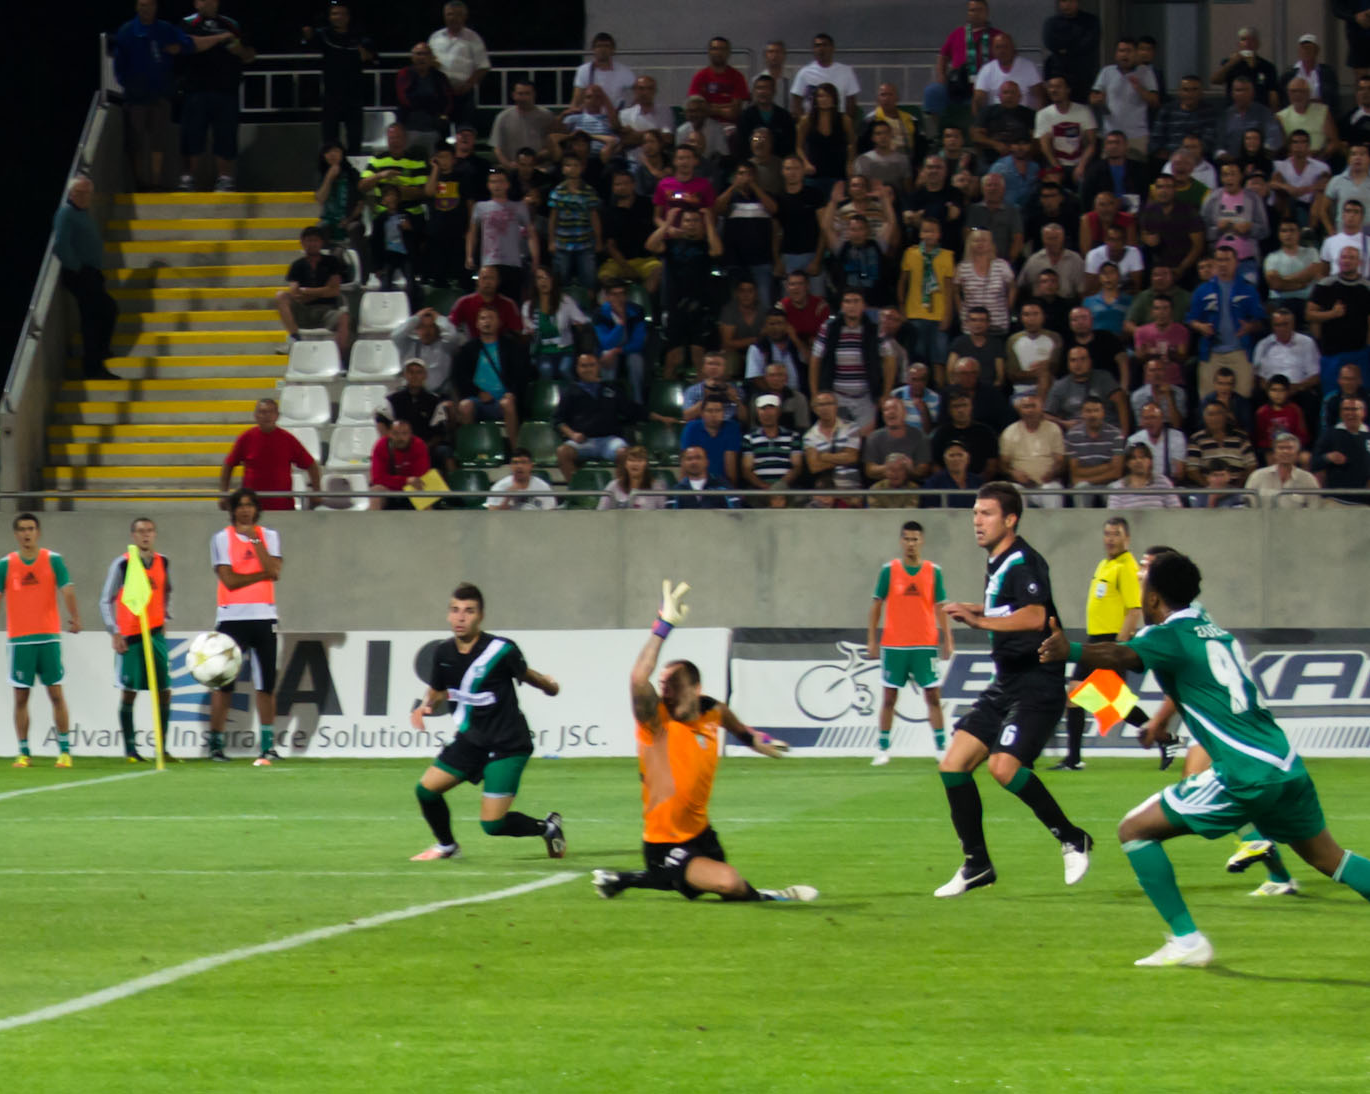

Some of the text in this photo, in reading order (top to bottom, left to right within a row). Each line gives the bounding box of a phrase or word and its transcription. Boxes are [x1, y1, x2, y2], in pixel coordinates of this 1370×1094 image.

[317, 723, 445, 749] Solutions
[556, 724, 608, 752] JSC.
[999, 724, 1020, 747] 6
